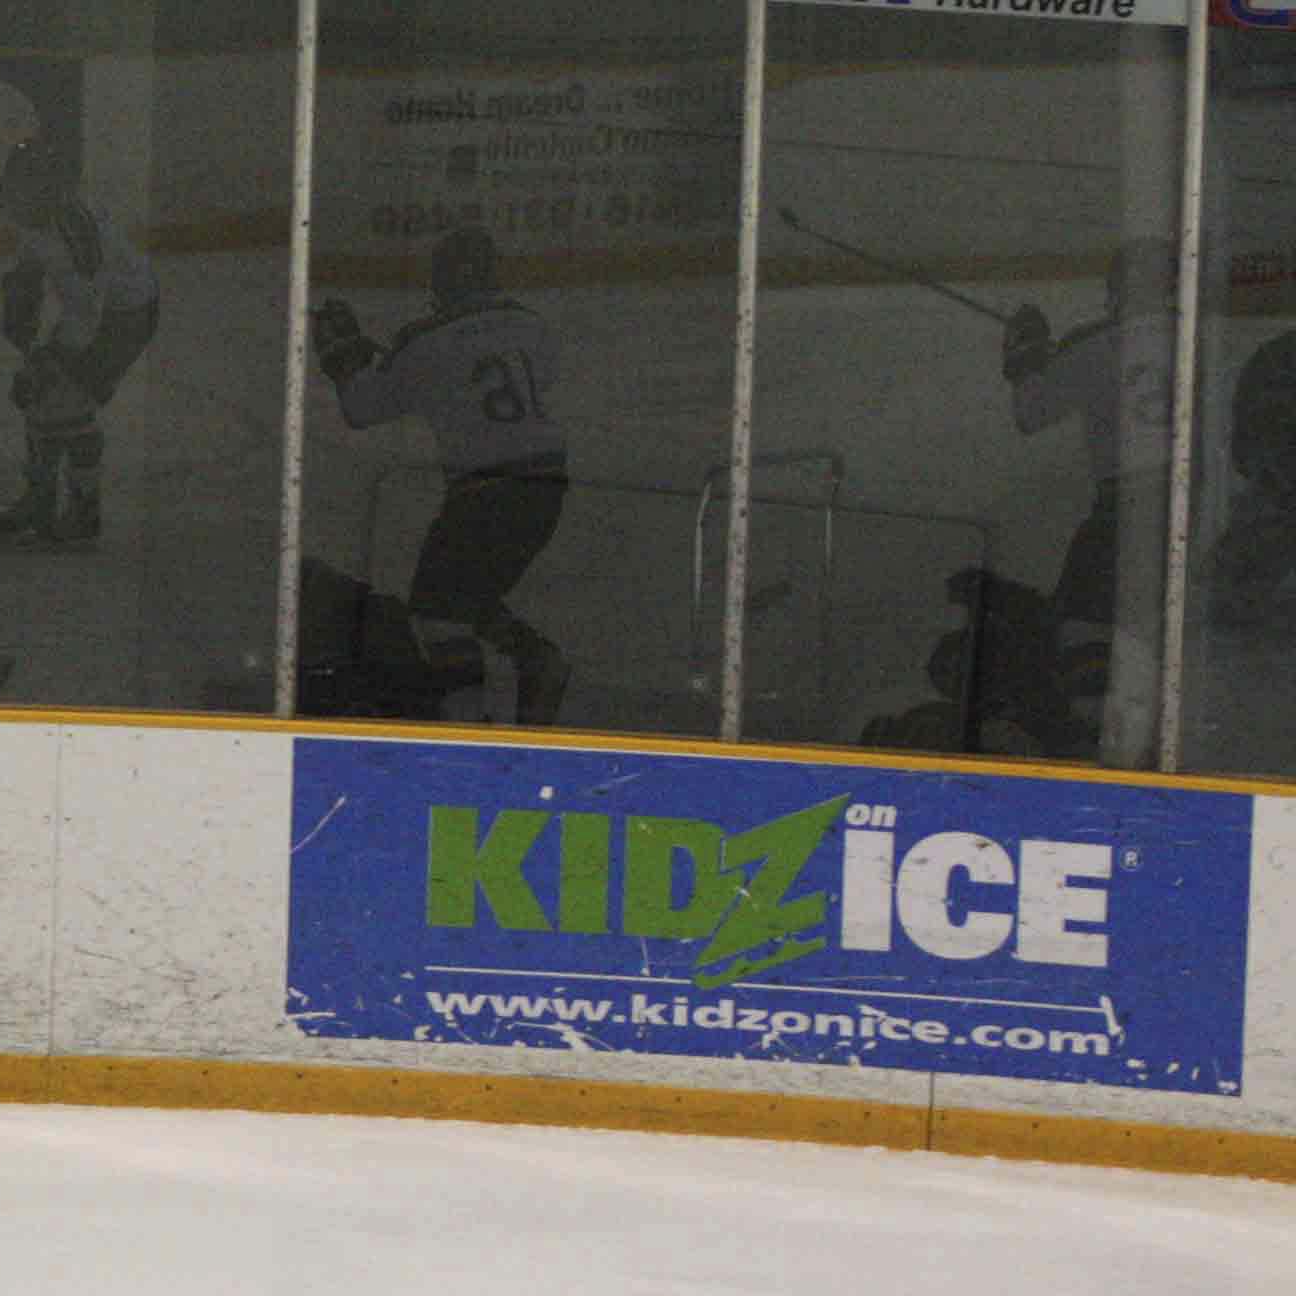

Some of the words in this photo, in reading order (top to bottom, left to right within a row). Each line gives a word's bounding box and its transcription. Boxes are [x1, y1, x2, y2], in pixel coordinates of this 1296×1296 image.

[426, 792, 850, 988] KIDZ
[845, 804, 897, 827] on
[426, 991, 1109, 1056] www.kidzonice.com
